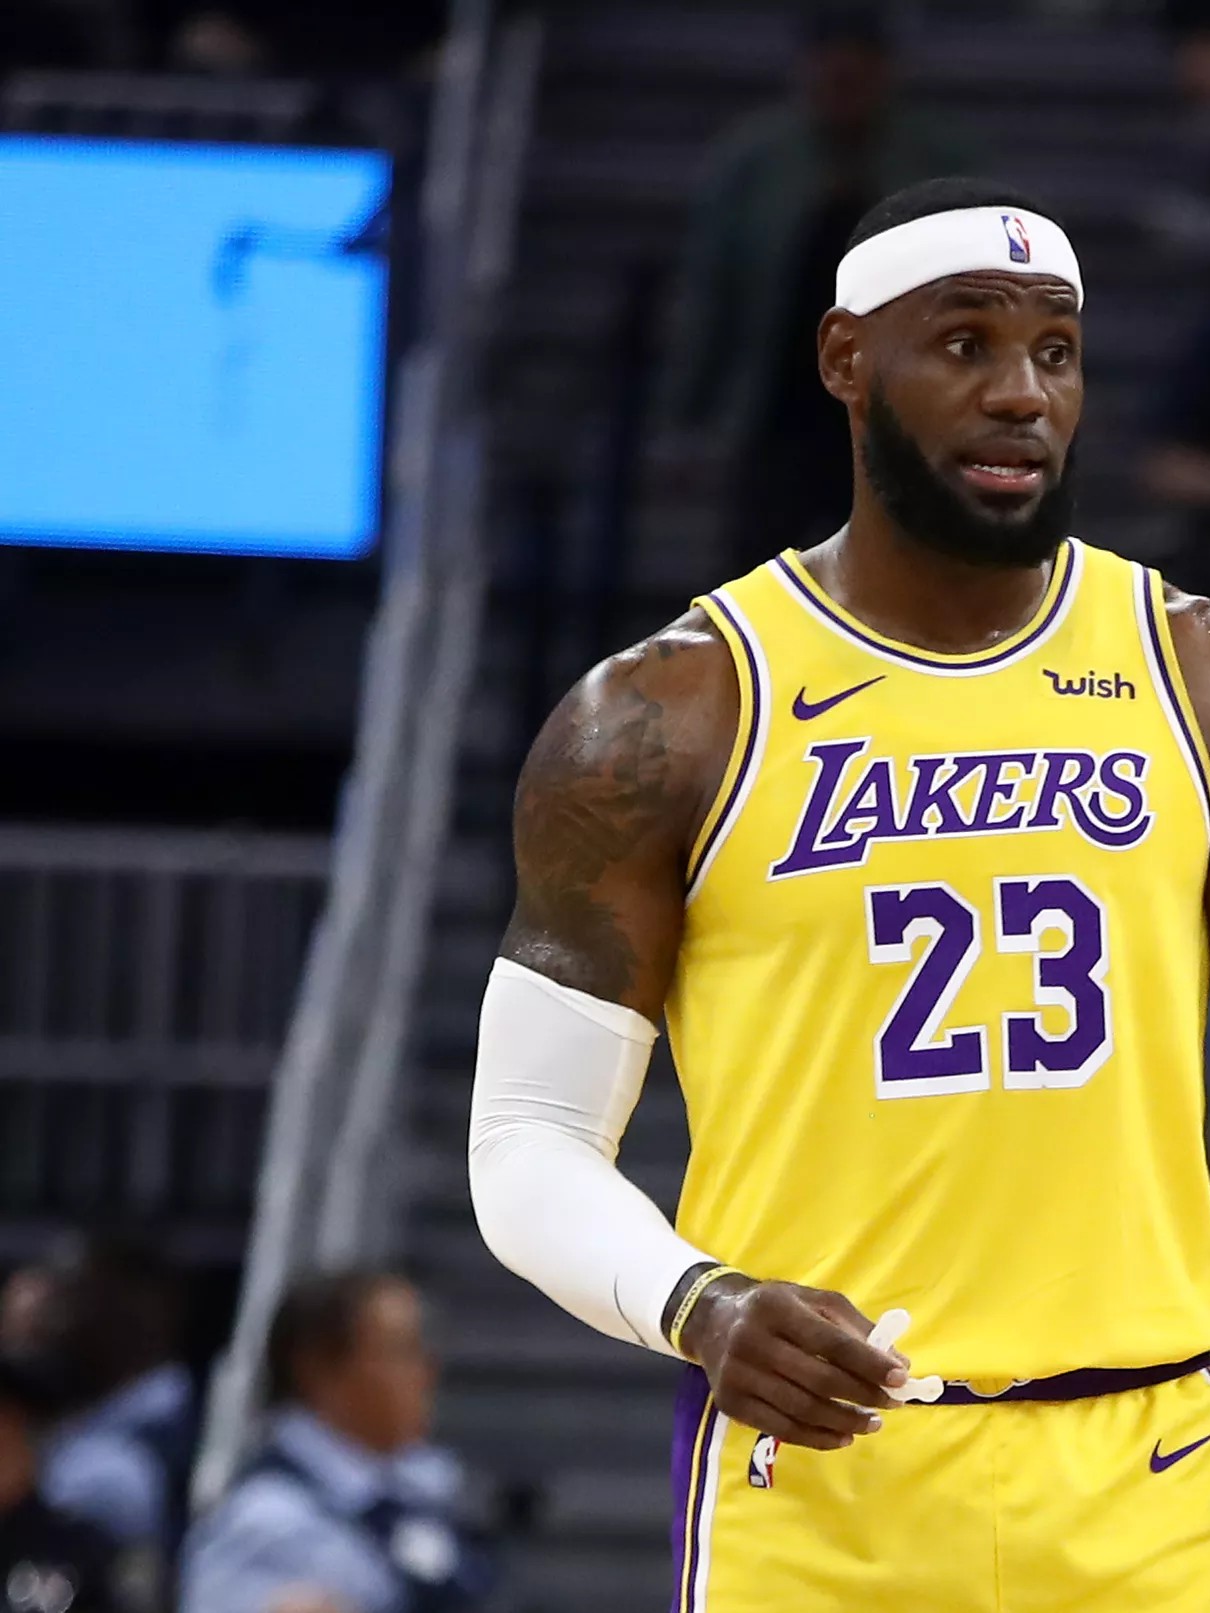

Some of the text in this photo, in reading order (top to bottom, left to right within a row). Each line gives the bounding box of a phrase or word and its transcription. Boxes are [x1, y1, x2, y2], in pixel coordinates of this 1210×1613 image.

[1043, 668, 1135, 699] wish
[767, 736, 1154, 881] LAKERS
[864, 874, 1113, 1100] 23
